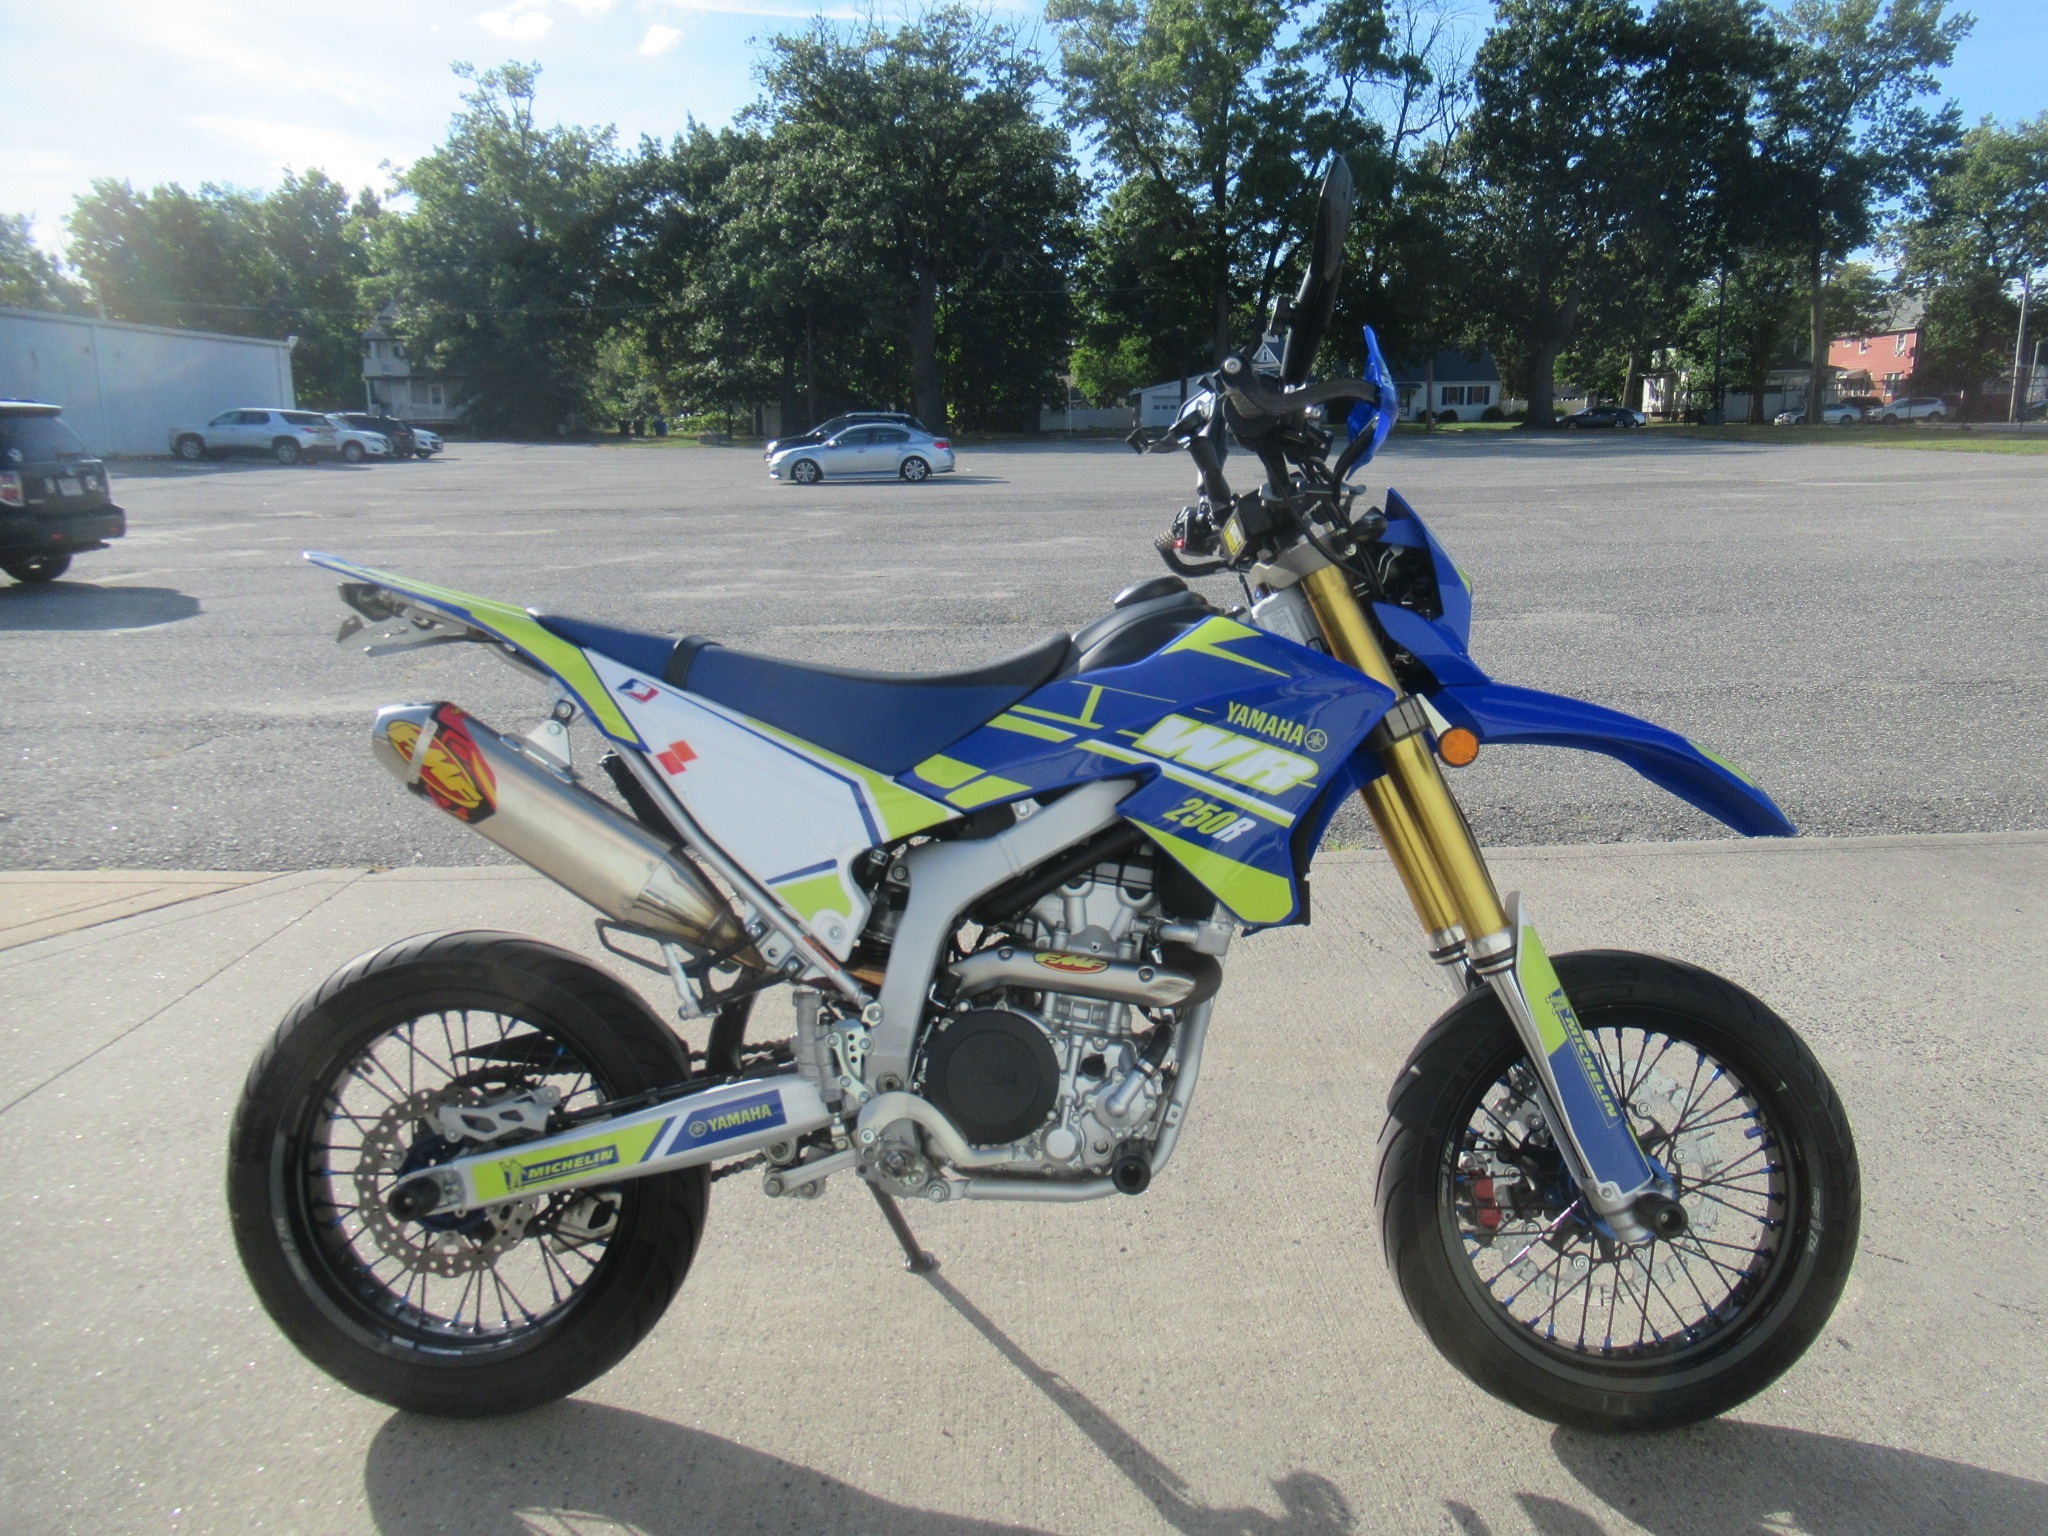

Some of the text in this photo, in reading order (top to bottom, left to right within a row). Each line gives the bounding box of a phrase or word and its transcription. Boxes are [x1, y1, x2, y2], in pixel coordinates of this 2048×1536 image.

[1226, 700, 1305, 747] YAMAHA
[1131, 713, 1319, 796] WR
[1162, 797, 1257, 843] 250R
[1565, 1016, 1618, 1118] MICHELIN
[707, 1103, 772, 1133] YAMAHA
[527, 1148, 615, 1180] MICHELIN
